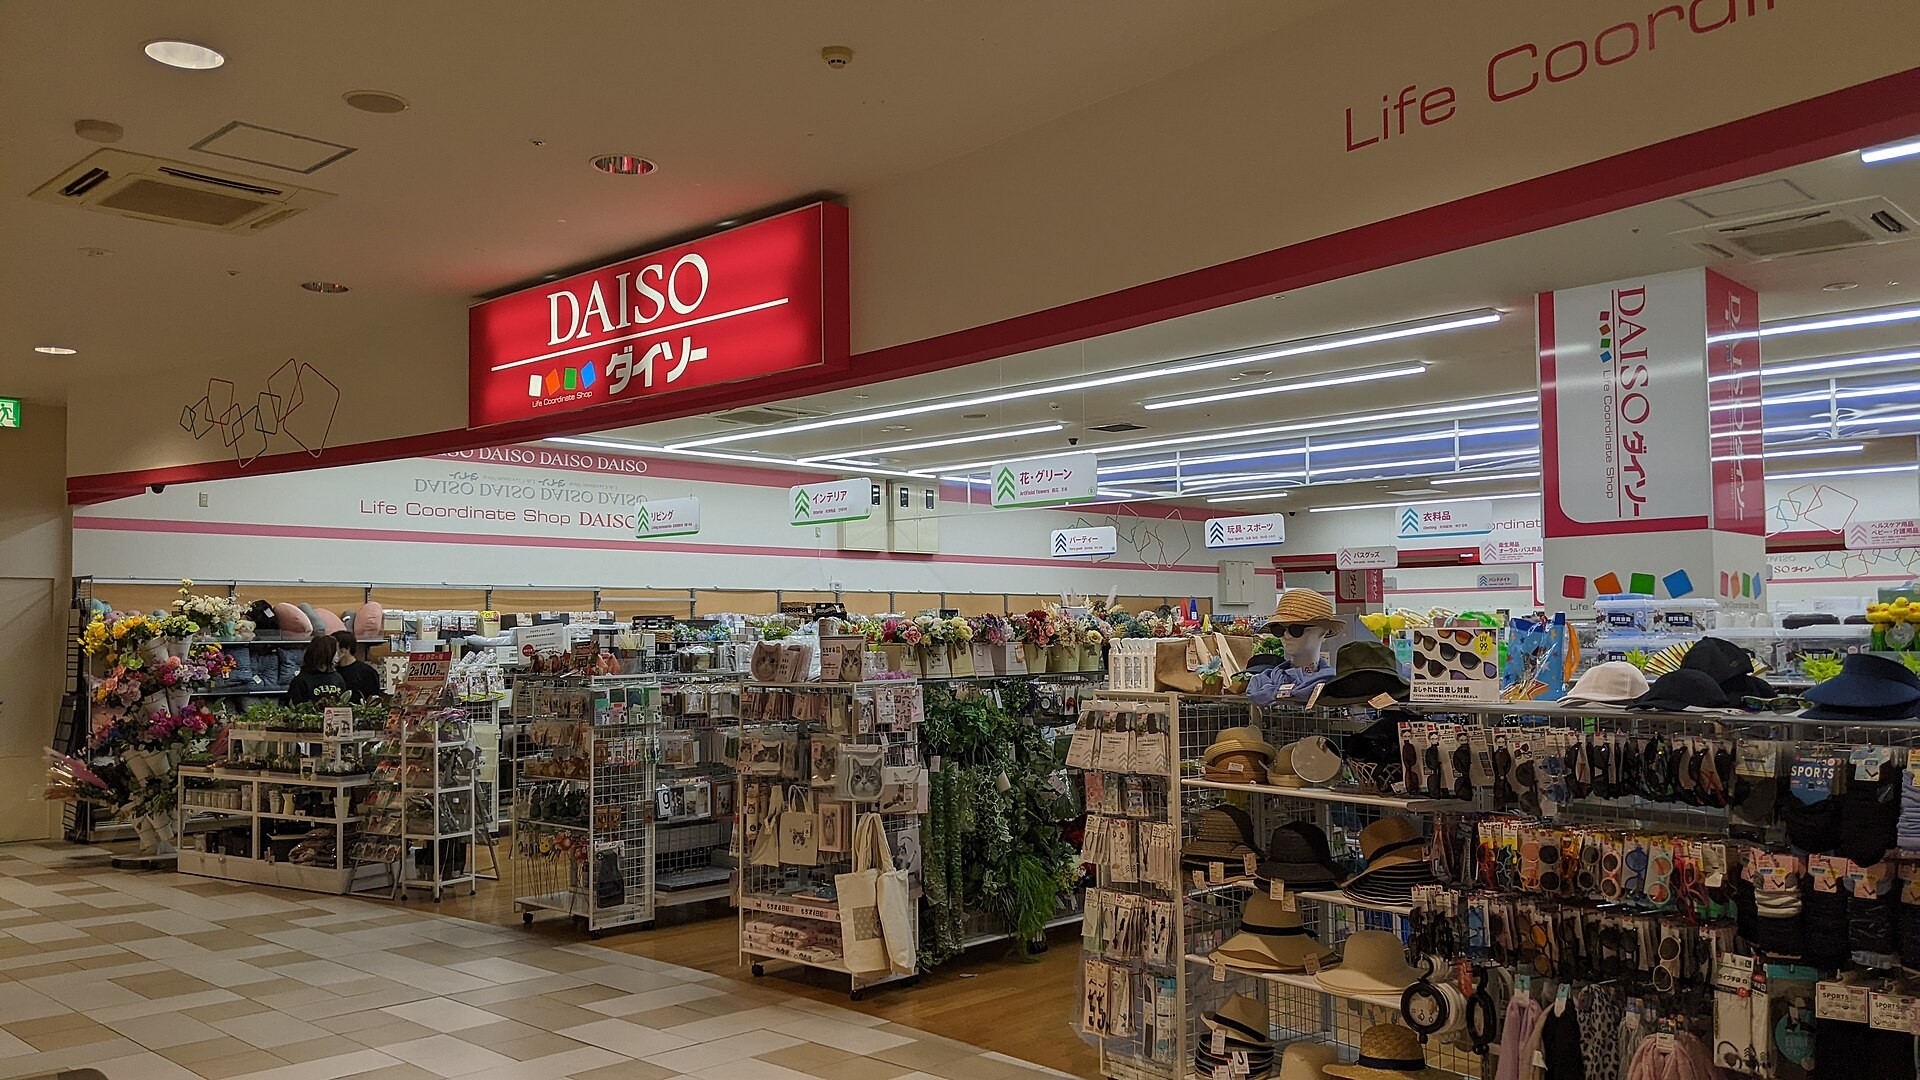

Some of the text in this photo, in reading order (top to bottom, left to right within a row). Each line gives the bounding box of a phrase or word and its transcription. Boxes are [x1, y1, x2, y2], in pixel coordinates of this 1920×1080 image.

[1345, 0, 1775, 152] Life Coord
[547, 253, 709, 346] DAISO
[1618, 285, 1650, 424] DAISO
[606, 336, 708, 394] ダイソー
[532, 391, 593, 408] Life Coordinate Shop
[1604, 396, 1613, 463] Coordinate
[478, 447, 535, 464] DAISO
[539, 451, 593, 469] DAISO
[597, 457, 648, 473] DAISO
[1019, 468, 1073, 486] 花・グリーン
[1622, 431, 1647, 516] ダイソー
[1606, 467, 1615, 499] Shop
[812, 490, 848, 505] インテリア
[360, 500, 398, 515] Life
[405, 502, 516, 521] Coordinate
[523, 509, 571, 527] Shop
[651, 510, 674, 521] リビング
[1423, 510, 1451, 522] 衣料品
[1227, 522, 1274, 534] 玩具・スポーツ
[1069, 536, 1098, 544] パーティー
[1570, 603, 1588, 611] Life
[1791, 765, 1834, 779] SPORTS
[1823, 992, 1849, 1000] SPORTS
